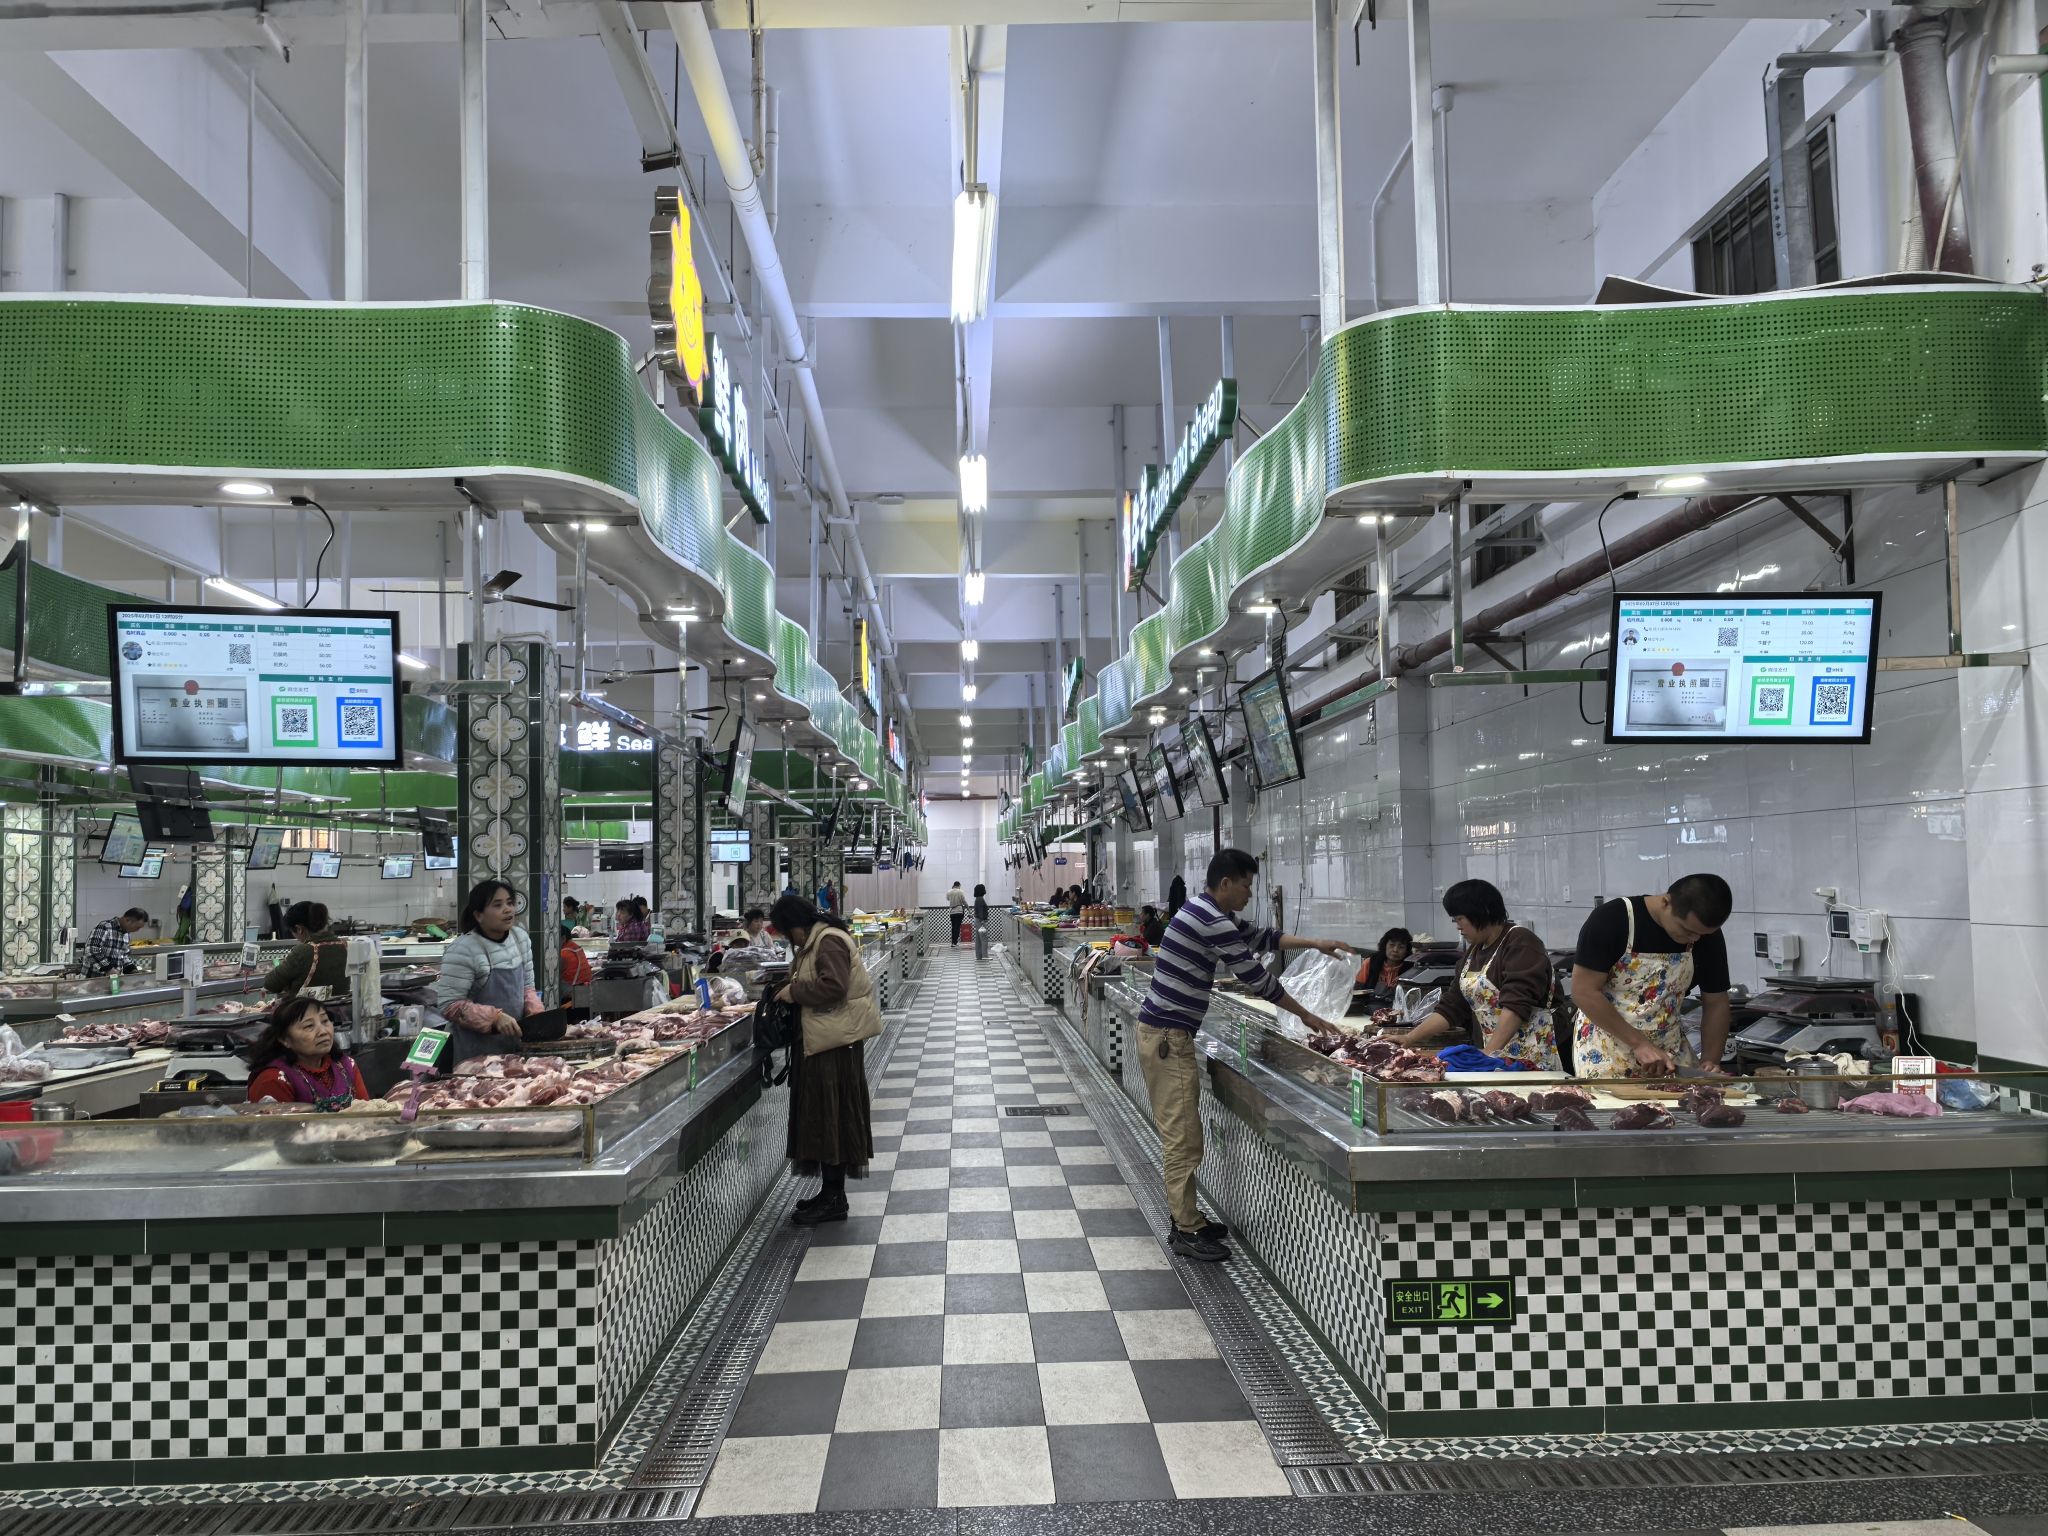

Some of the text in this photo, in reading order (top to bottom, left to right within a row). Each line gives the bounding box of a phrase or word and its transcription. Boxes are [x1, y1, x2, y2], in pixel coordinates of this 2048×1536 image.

[713, 334, 751, 490] 鲜肉
[1172, 424, 1188, 493] and
[1190, 379, 1223, 463] sheep
[1657, 678, 1698, 688] 营业执照
[169, 698, 215, 708] 营业执照
[1396, 1290, 1430, 1303] 安全出口
